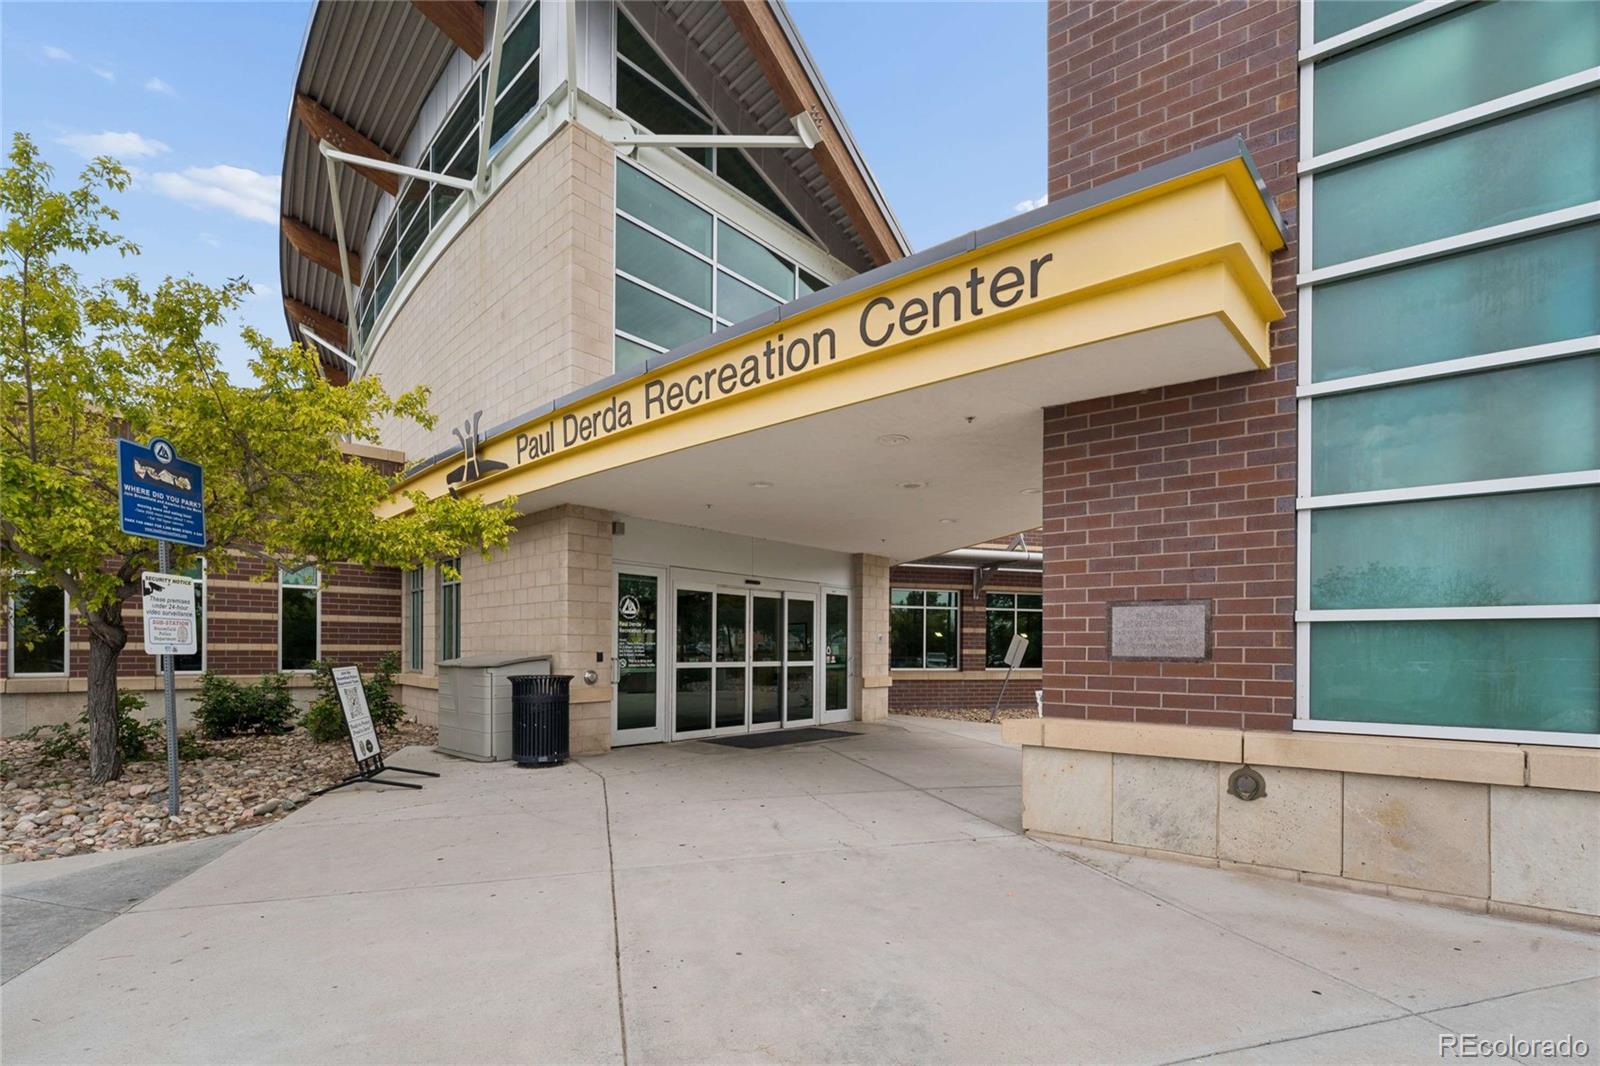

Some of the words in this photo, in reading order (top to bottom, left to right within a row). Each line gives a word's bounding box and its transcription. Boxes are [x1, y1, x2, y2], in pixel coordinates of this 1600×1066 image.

[516, 420, 556, 465] Paul
[563, 396, 633, 449] Derda
[644, 325, 836, 420] Recreation
[858, 252, 1054, 348] Center
[124, 484, 150, 496] WHERE
[152, 490, 164, 500] DID
[166, 494, 180, 504] YOU
[182, 498, 201, 508] PARK?
[145, 576, 171, 584] SECURITY
